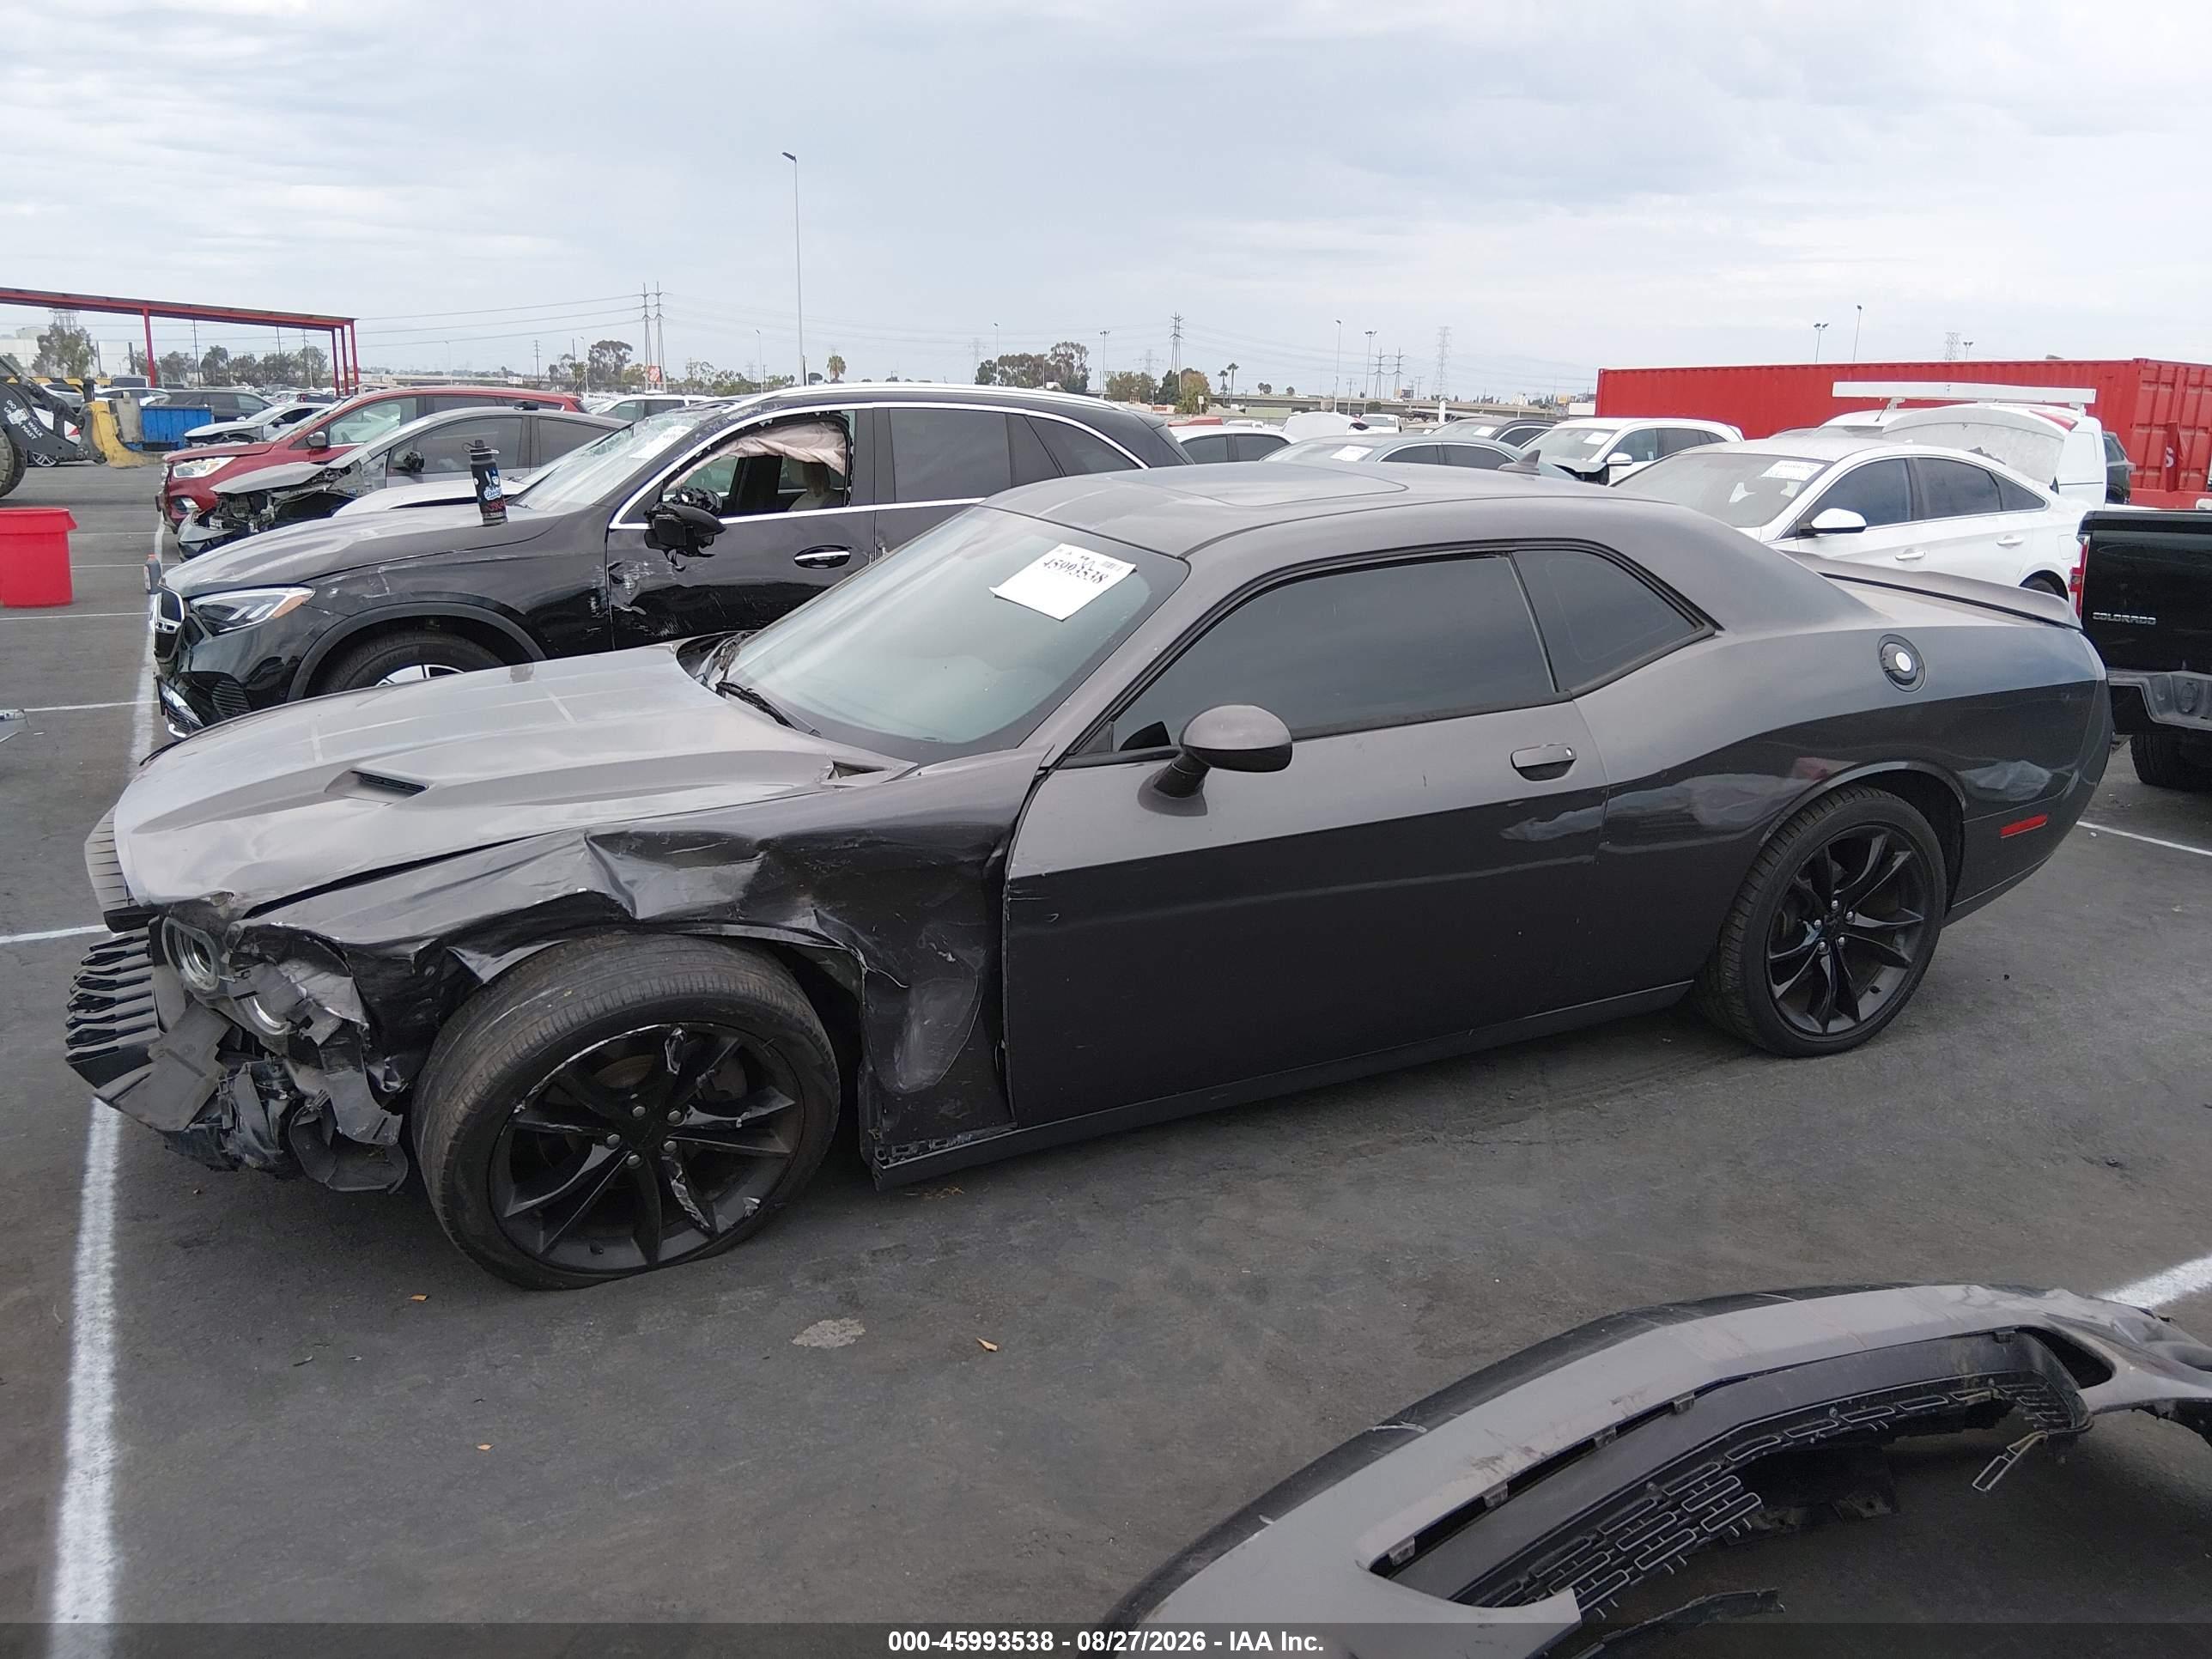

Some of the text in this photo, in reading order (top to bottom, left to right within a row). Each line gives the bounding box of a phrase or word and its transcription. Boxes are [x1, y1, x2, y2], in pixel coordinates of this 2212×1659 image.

[21, 425, 37, 440] MAST
[27, 421, 43, 438] WALK
[2092, 611, 2157, 626] COLORADO
